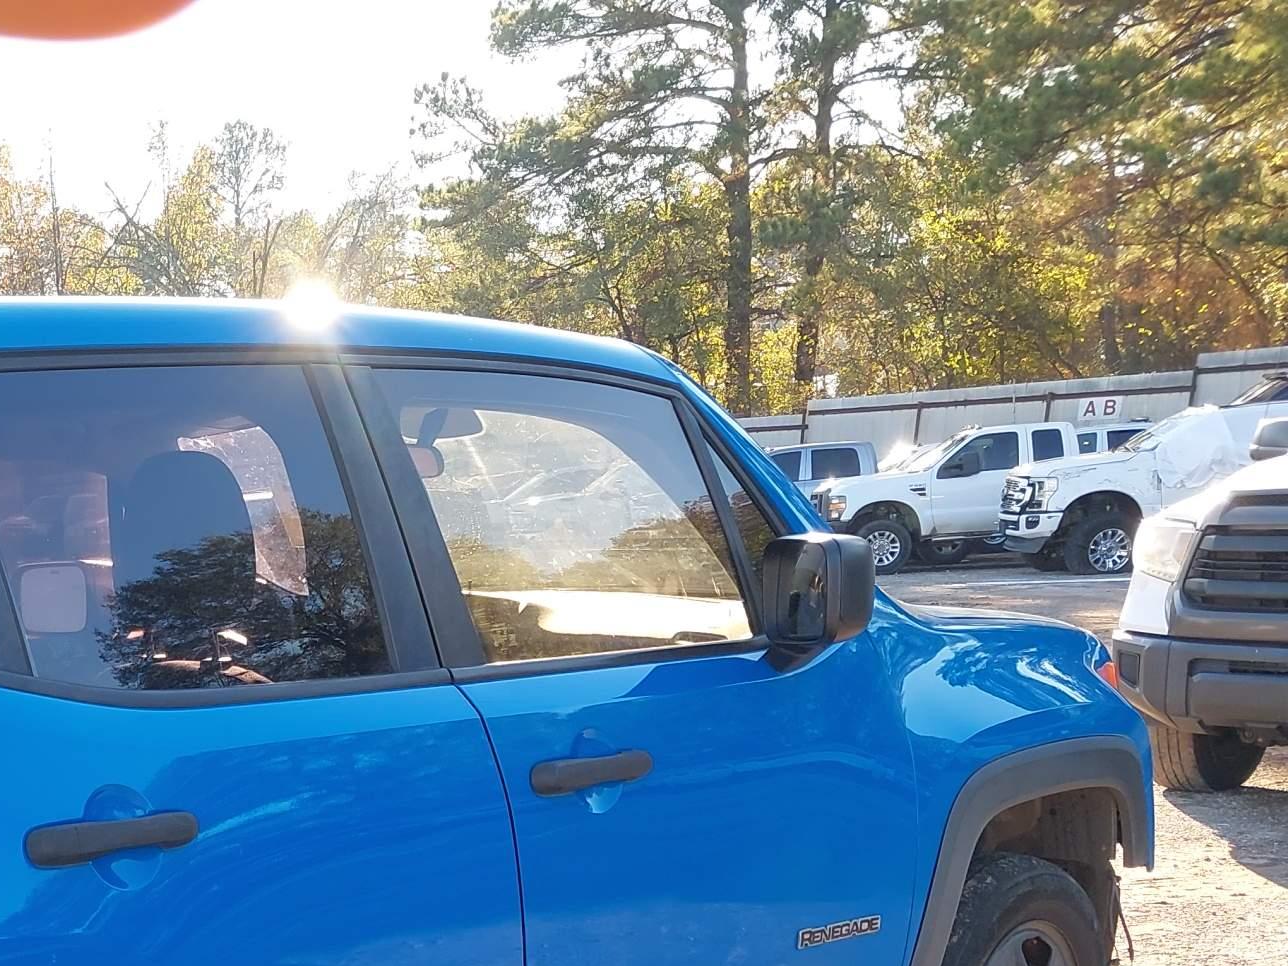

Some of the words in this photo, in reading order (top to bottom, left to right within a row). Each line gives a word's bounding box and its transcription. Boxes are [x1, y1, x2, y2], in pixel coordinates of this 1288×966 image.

[1083, 400, 1096, 417] A
[1103, 399, 1117, 416] B
[798, 915, 881, 950] RENEGADE
